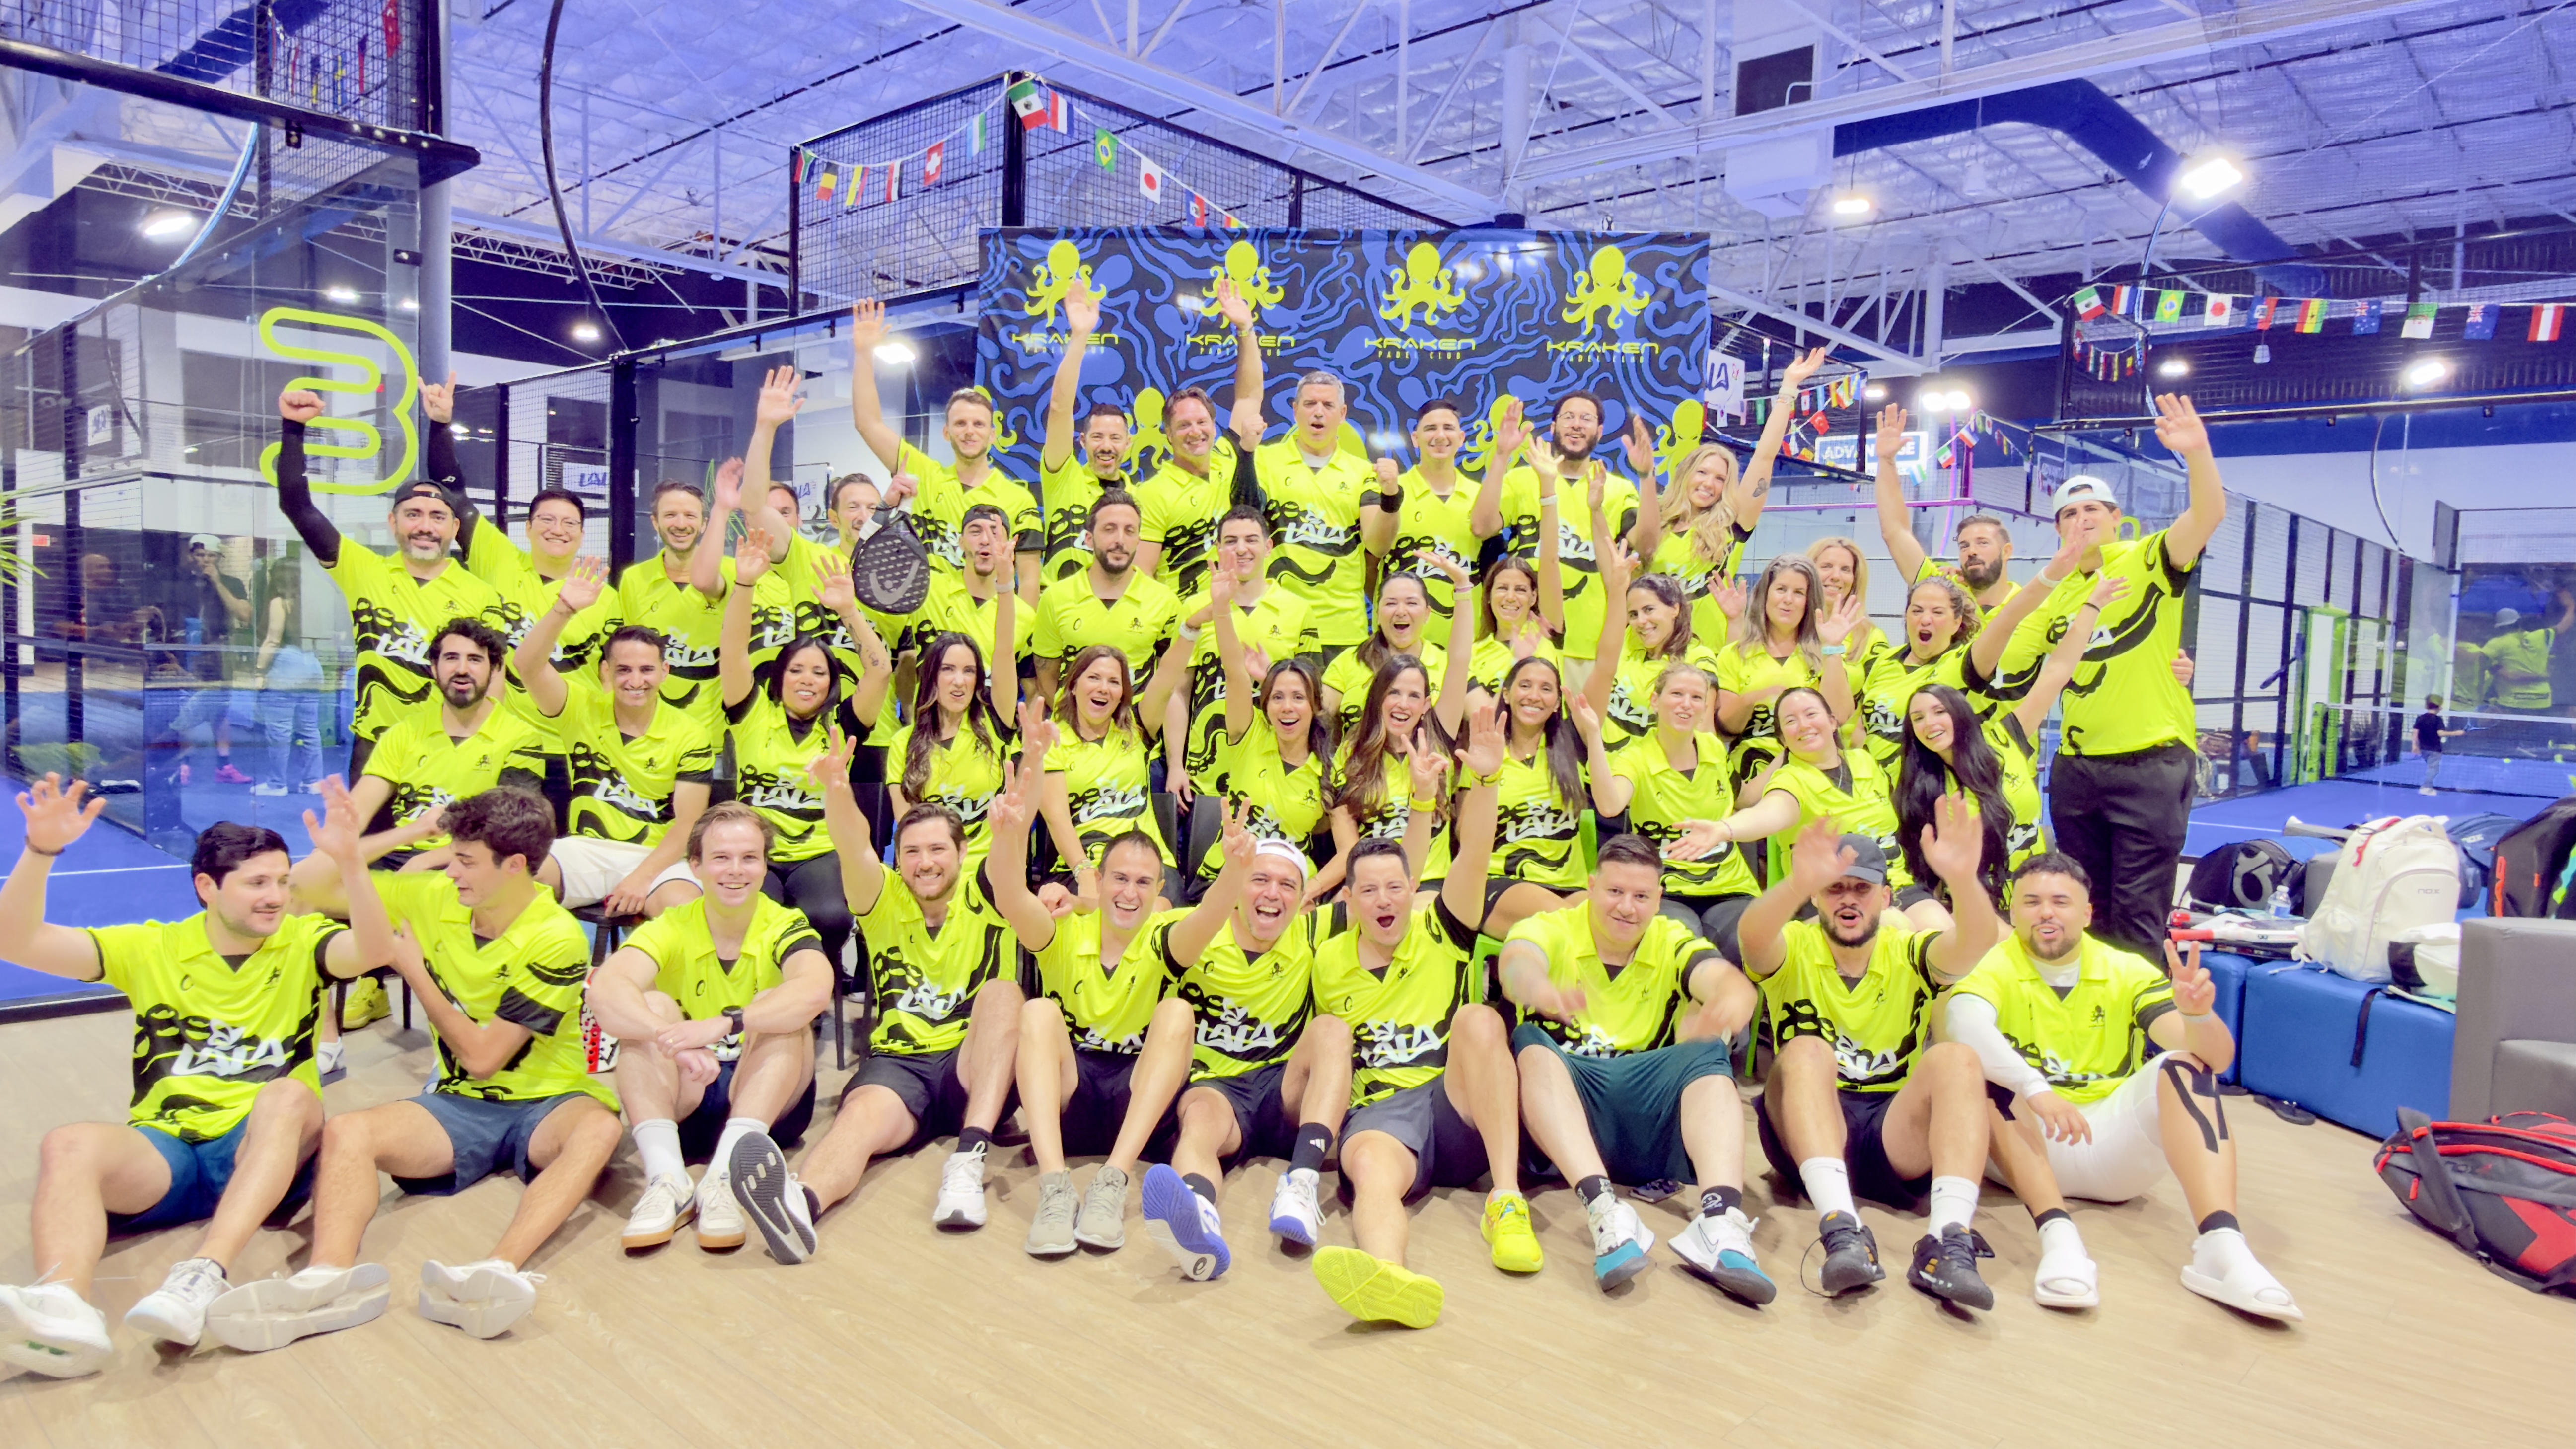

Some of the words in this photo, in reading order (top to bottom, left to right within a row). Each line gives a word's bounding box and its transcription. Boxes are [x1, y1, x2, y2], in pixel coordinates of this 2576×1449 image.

[1187, 334, 1295, 347] KRAEN
[1365, 338, 1475, 350] KRAKEN
[1547, 341, 1659, 354] KRAKEN
